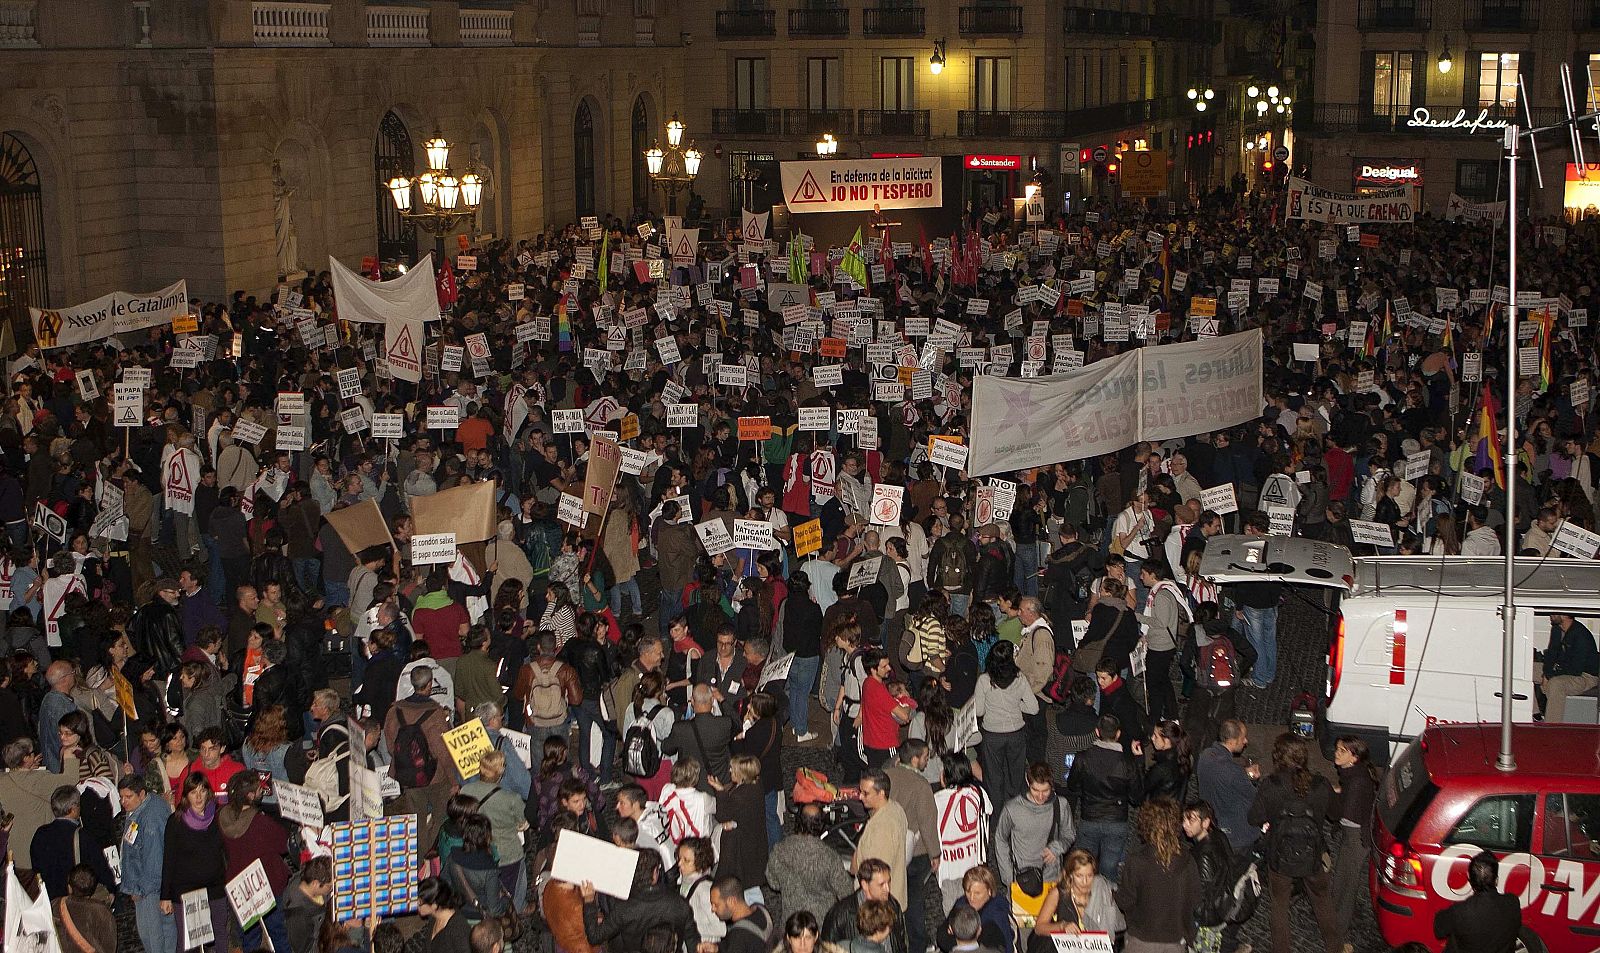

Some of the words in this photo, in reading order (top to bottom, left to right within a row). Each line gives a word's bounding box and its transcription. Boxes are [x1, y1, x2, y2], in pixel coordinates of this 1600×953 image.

[980, 158, 1015, 169] Santander
[831, 171, 842, 183] En
[845, 169, 878, 183] defensa
[880, 170, 891, 182] de
[893, 170, 901, 182] la
[903, 168, 933, 181] laïcitat
[831, 186, 847, 202] JO
[850, 185, 868, 201] NO
[872, 182, 933, 200] T'ESPERO
[1329, 202, 1343, 217] LA
[1347, 204, 1365, 218] QUE
[67, 309, 107, 328] Ateus
[111, 300, 125, 316] de
[127, 292, 186, 313] Catalunya
[873, 363, 899, 379] NO
[115, 387, 123, 395] NI
[124, 386, 142, 395] PAPA
[990, 480, 1015, 491] NO!
[36, 502, 65, 536] NO
[736, 524, 772, 536] VATICANO,
[412, 539, 418, 547] El
[418, 537, 438, 547] condón
[439, 536, 455, 545] salva.
[412, 551, 418, 559] El
[418, 551, 431, 560] papa
[432, 549, 455, 558] condena.
[452, 725, 469, 736] PRO
[448, 726, 484, 750] VIDA?
[460, 744, 478, 754] PRO
[950, 847, 965, 862] NO
[1056, 938, 1077, 950] Papa
